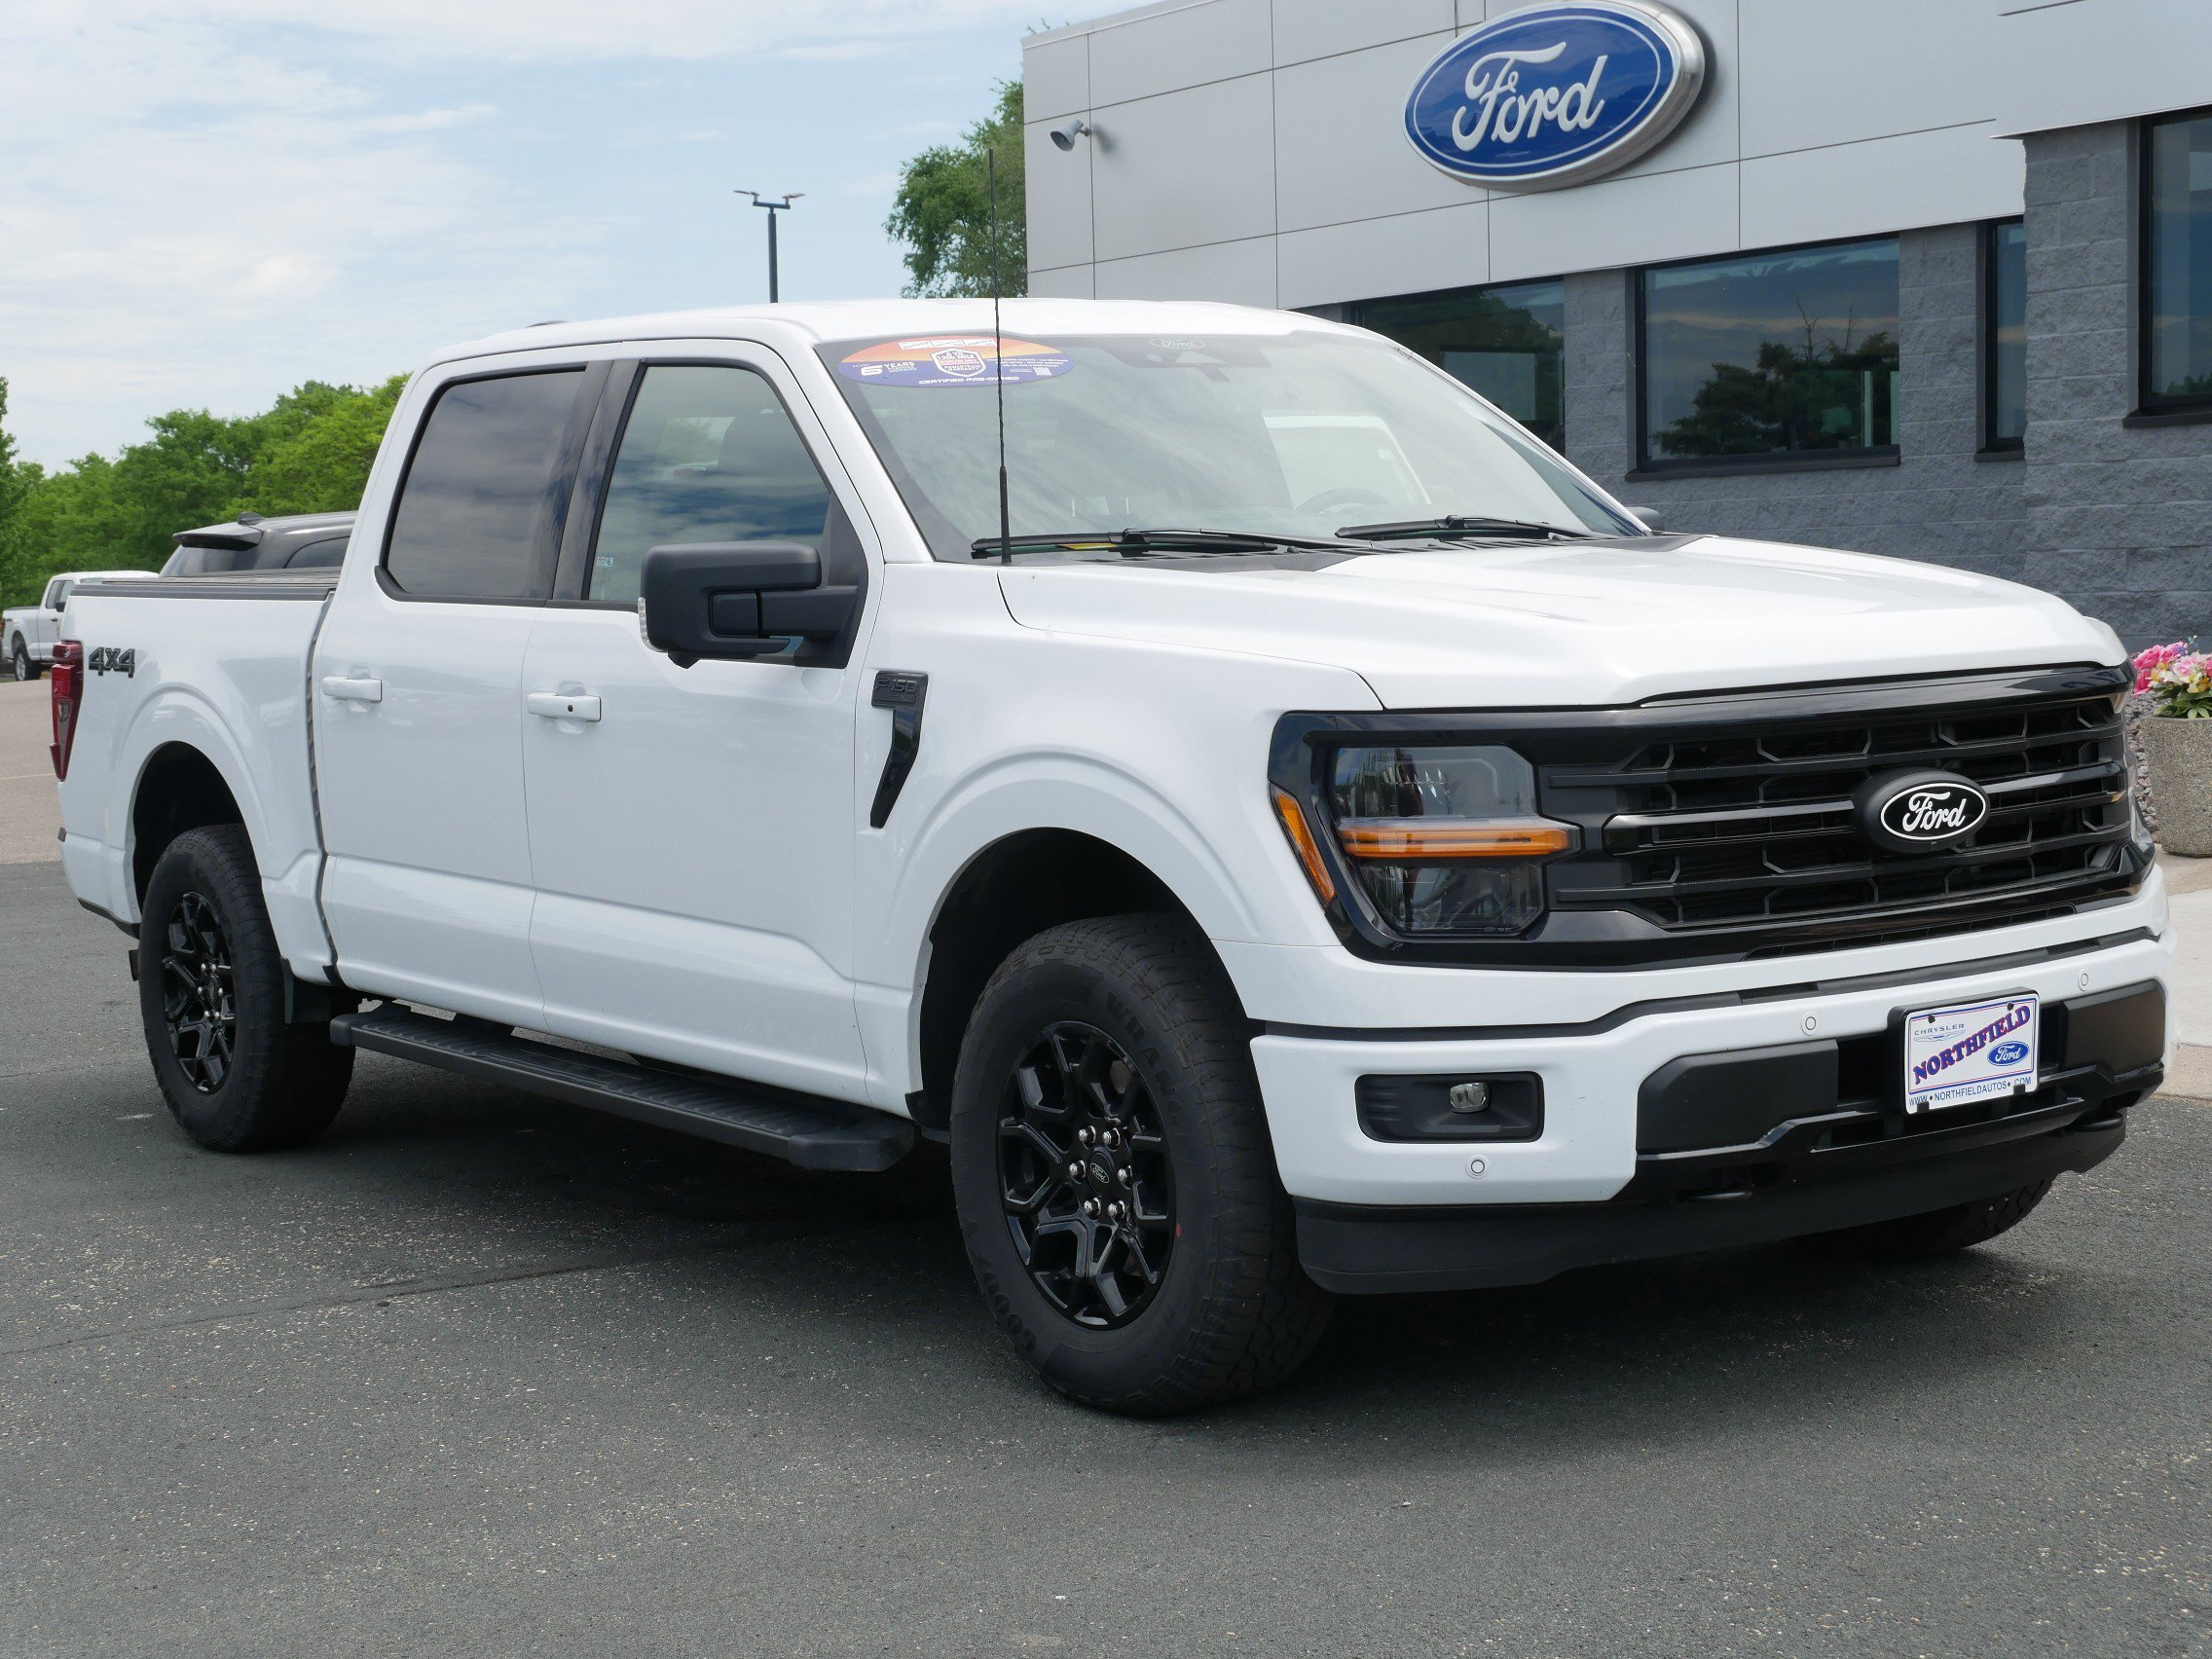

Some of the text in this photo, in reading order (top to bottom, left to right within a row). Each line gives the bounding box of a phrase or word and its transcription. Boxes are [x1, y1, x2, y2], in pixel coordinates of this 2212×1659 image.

[1452, 41, 1608, 152] Ford
[1902, 792, 1967, 832] Ford
[1913, 1006, 2031, 1085] NORTHFIELD
[1914, 1023, 1965, 1036] CHRYSLER
[1994, 1044, 2022, 1063] Ford
